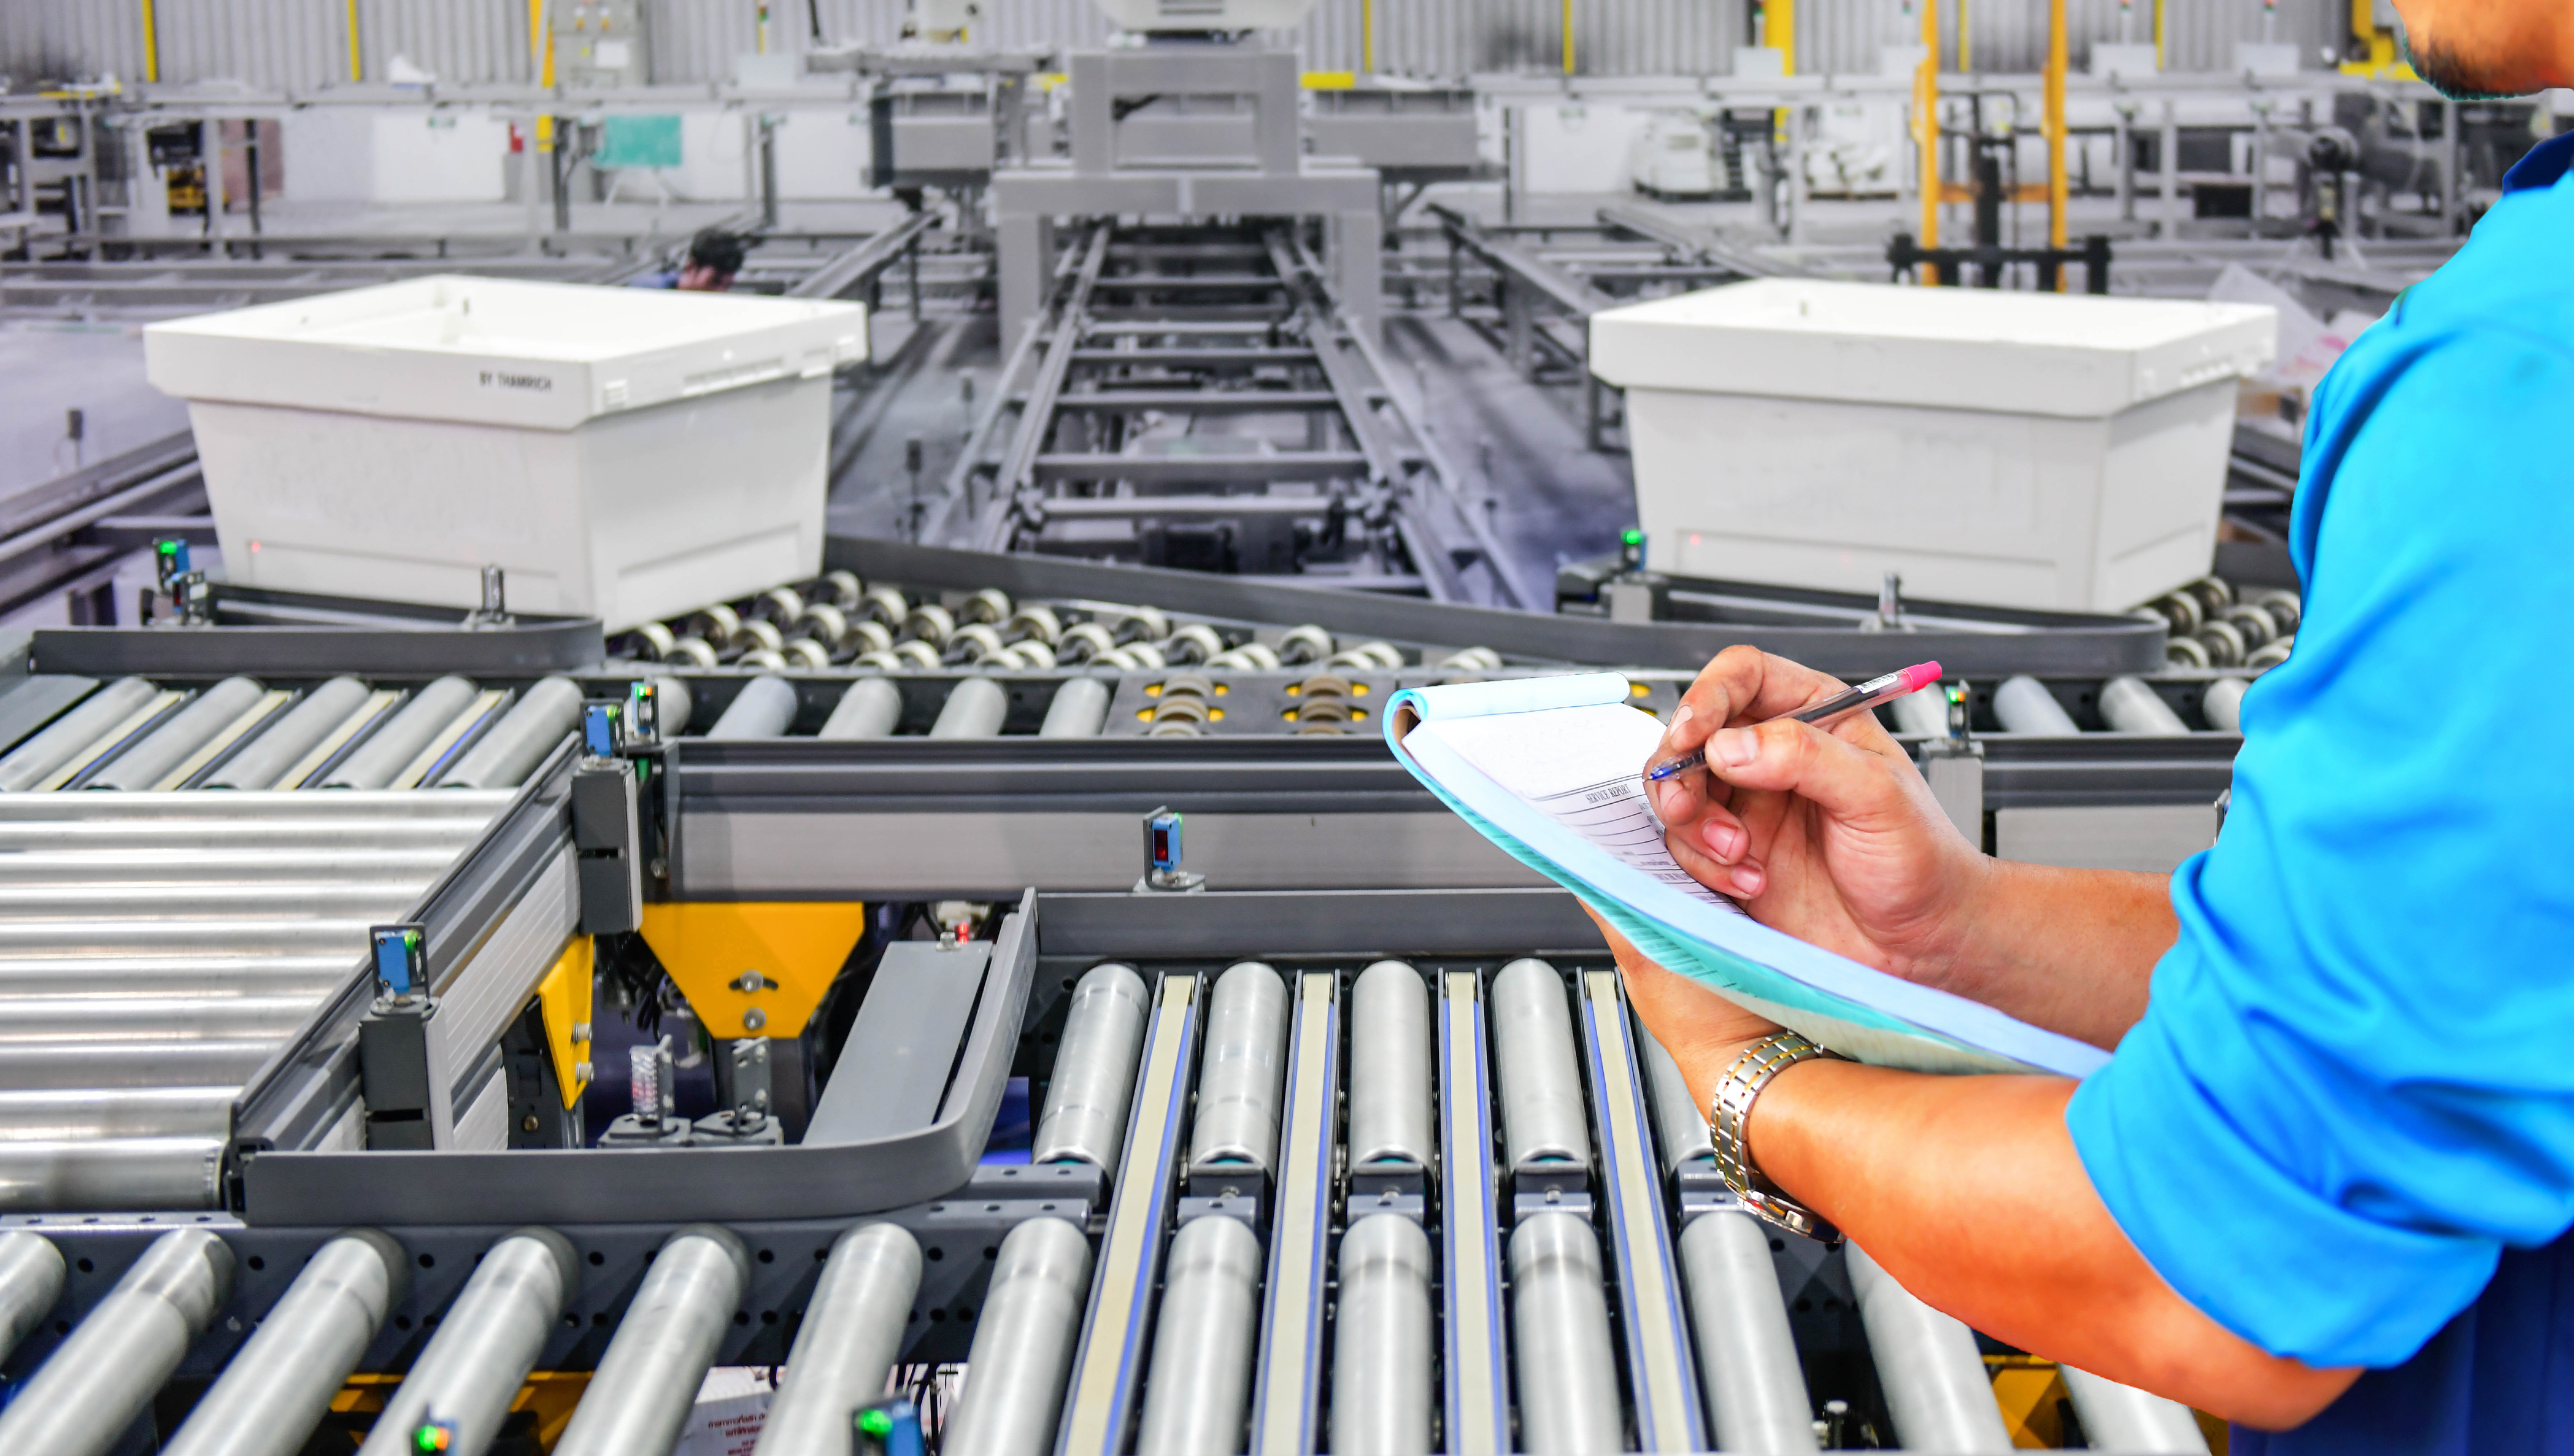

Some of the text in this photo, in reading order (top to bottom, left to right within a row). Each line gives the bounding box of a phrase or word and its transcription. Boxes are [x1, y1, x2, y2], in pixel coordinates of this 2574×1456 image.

[479, 371, 552, 391] BY THAMRICH
[1585, 784, 1631, 804] SERVICE REPORT
